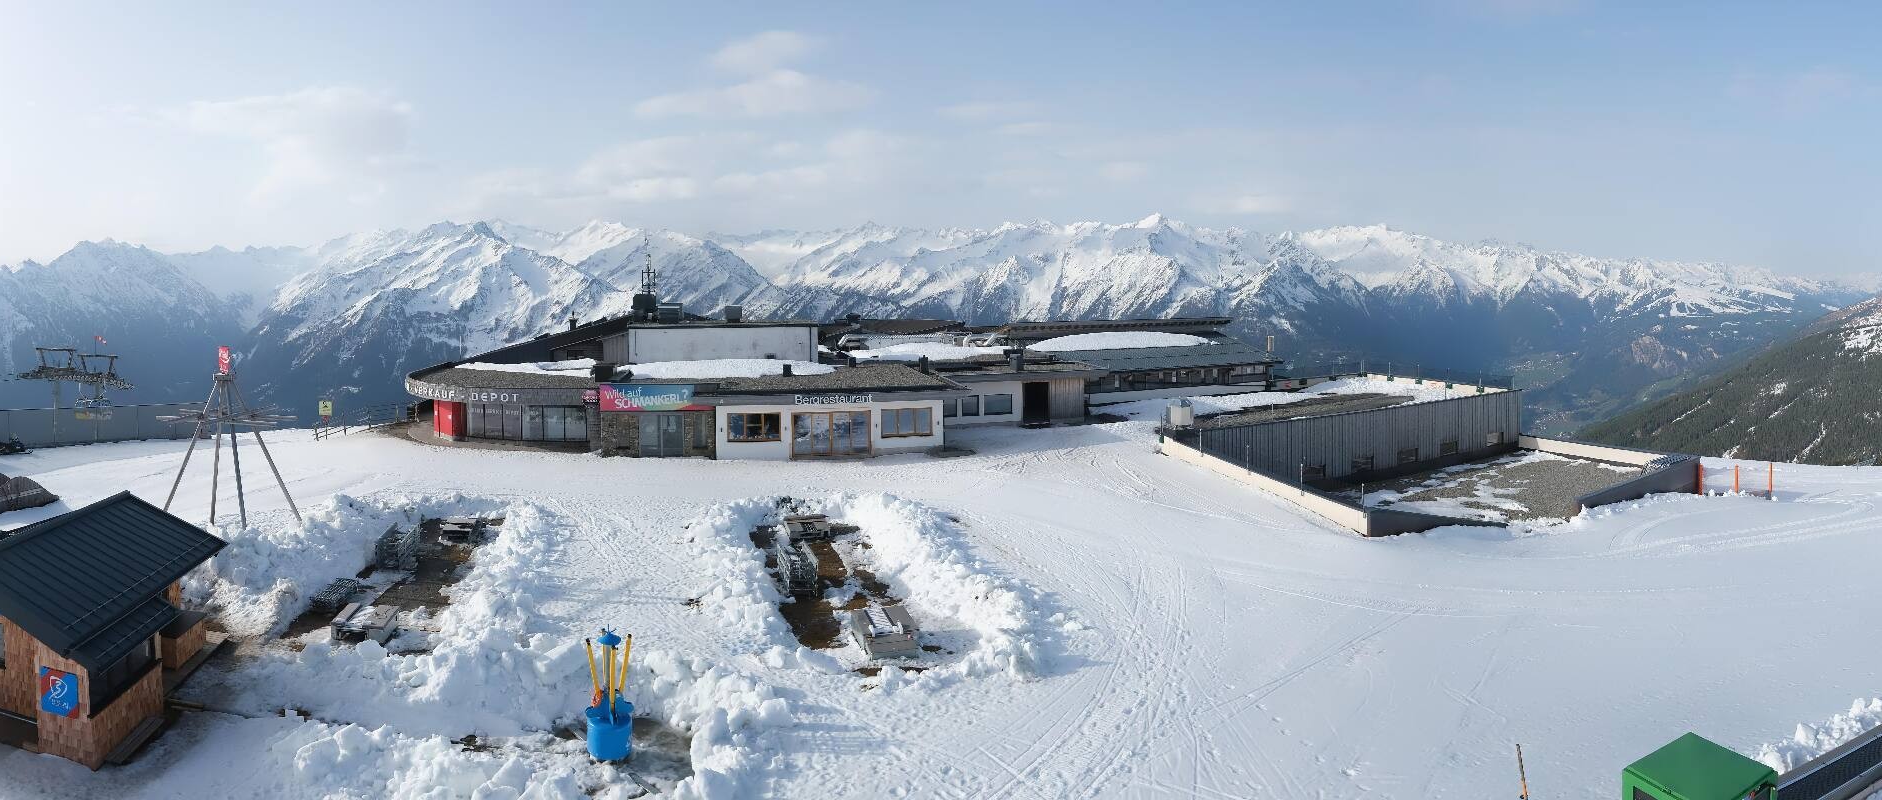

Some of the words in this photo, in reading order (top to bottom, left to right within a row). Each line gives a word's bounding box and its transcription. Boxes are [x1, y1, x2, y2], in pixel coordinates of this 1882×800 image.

[414, 386, 454, 399] VERKAUF
[471, 393, 519, 402] DEPOT
[605, 389, 624, 400] Wild
[627, 387, 642, 398] auf
[795, 394, 873, 405] Bergrestaurant
